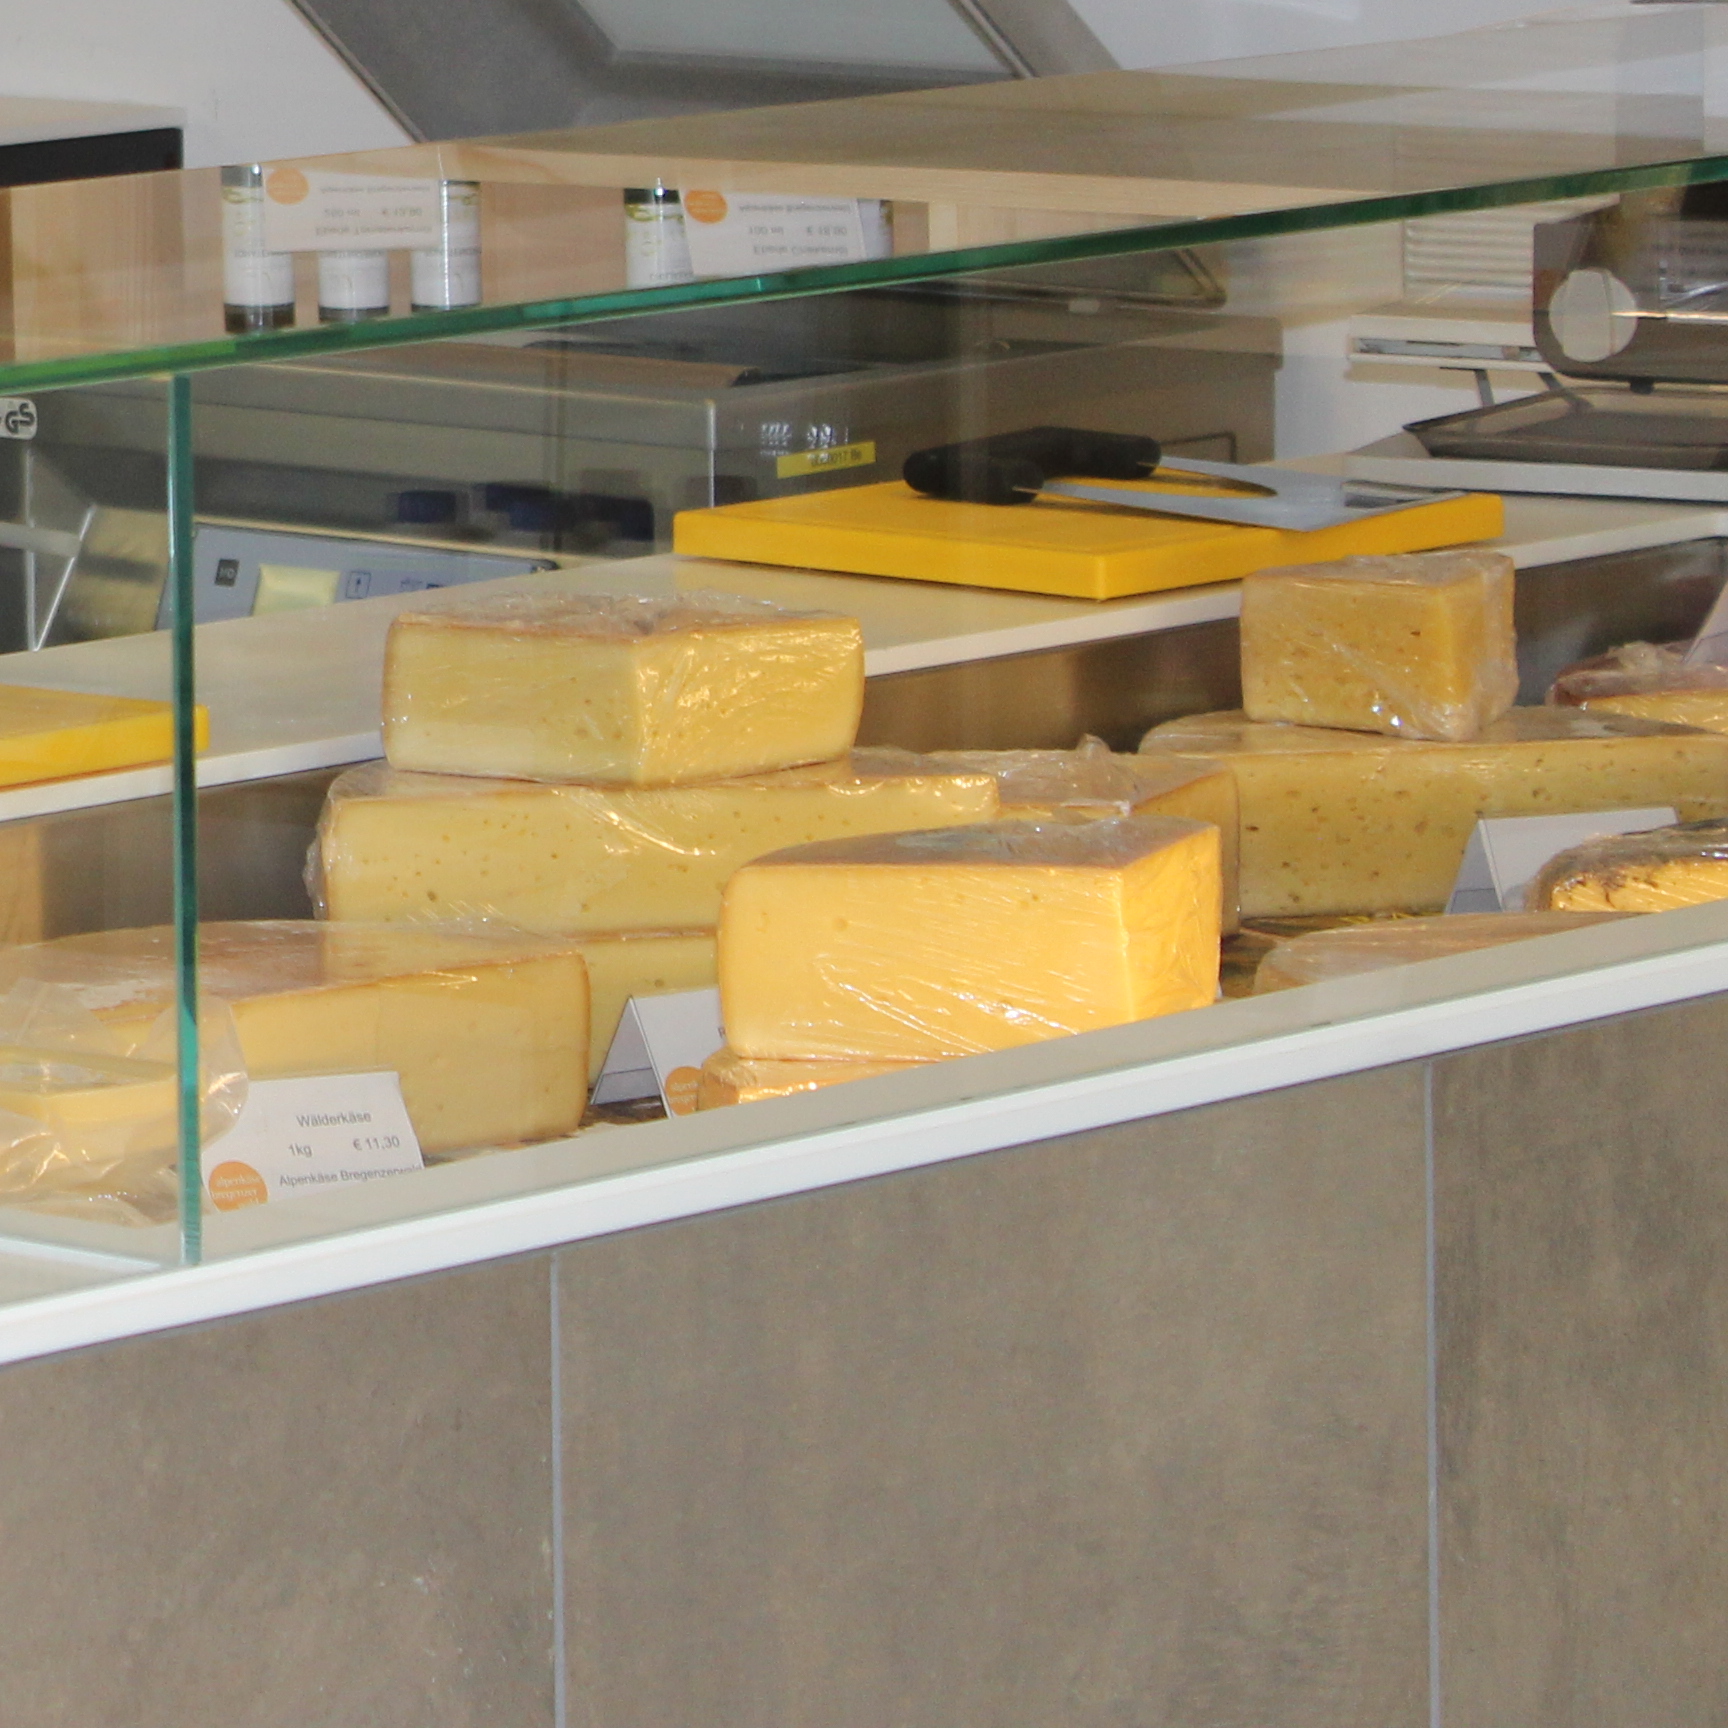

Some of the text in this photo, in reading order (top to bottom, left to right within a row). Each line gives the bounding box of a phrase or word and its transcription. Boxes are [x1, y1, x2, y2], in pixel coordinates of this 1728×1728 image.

[5, 402, 36, 434] GS
[295, 1110, 372, 1128] Wälderkäse
[288, 1135, 401, 1158] 1kg € 11,30
[279, 1170, 338, 1188] Alpenkäse
